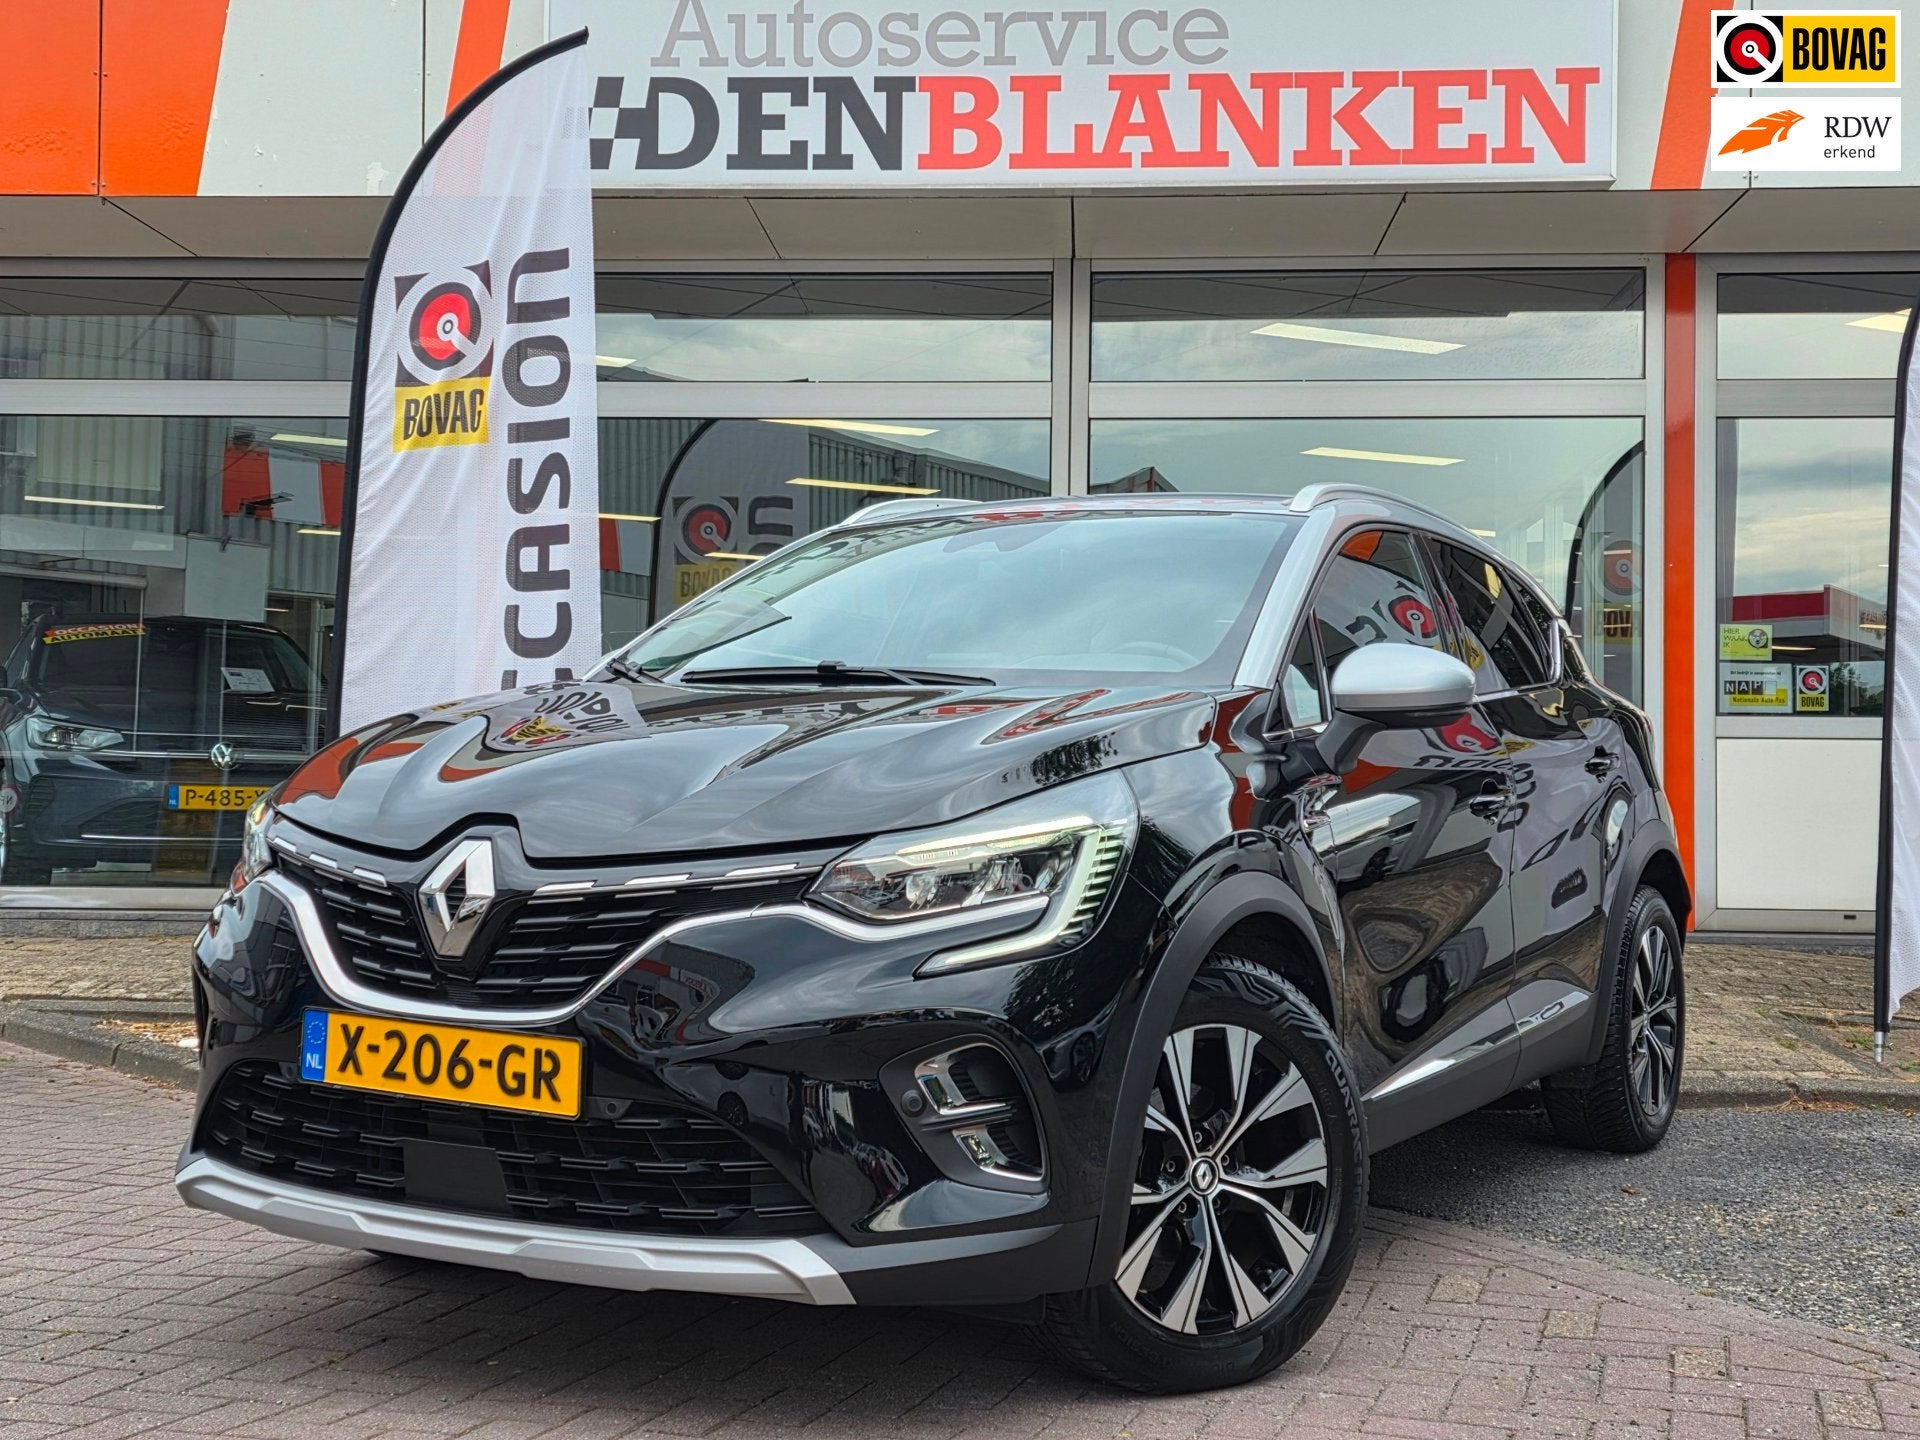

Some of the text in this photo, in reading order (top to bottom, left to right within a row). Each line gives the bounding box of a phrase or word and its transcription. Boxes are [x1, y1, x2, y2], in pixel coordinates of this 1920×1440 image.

[651, 0, 1229, 68] Autoservice
[403, 389, 484, 440] BOVAG
[50, 629, 141, 643] AUTOMAAT
[55, 623, 138, 635] OCCASION
[1801, 696, 1825, 707] BOVAG
[306, 1023, 562, 1103] NL X-206-GR
